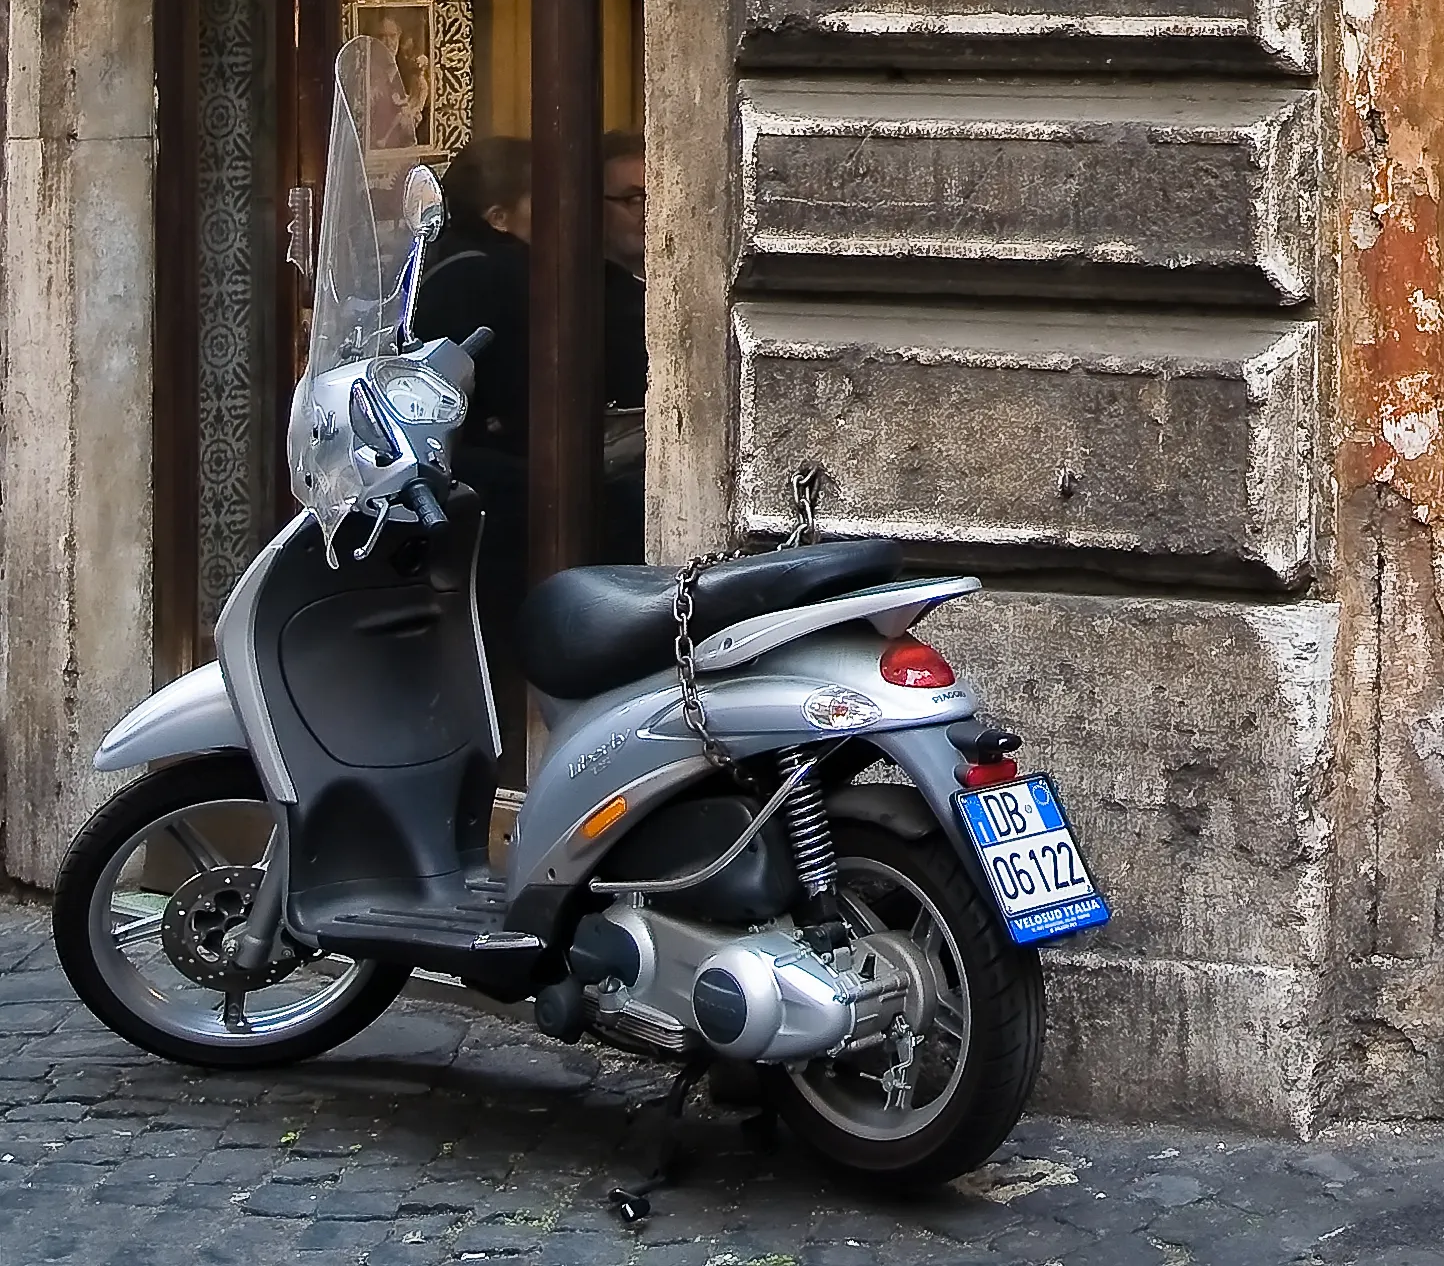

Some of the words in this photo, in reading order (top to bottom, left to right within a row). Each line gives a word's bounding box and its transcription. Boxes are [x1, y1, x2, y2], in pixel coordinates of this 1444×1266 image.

[983, 791, 1027, 838] DB
[992, 841, 1086, 900] 06122
[1013, 907, 1063, 931] VELOSUD
[1063, 899, 1101, 919] ITALIA
